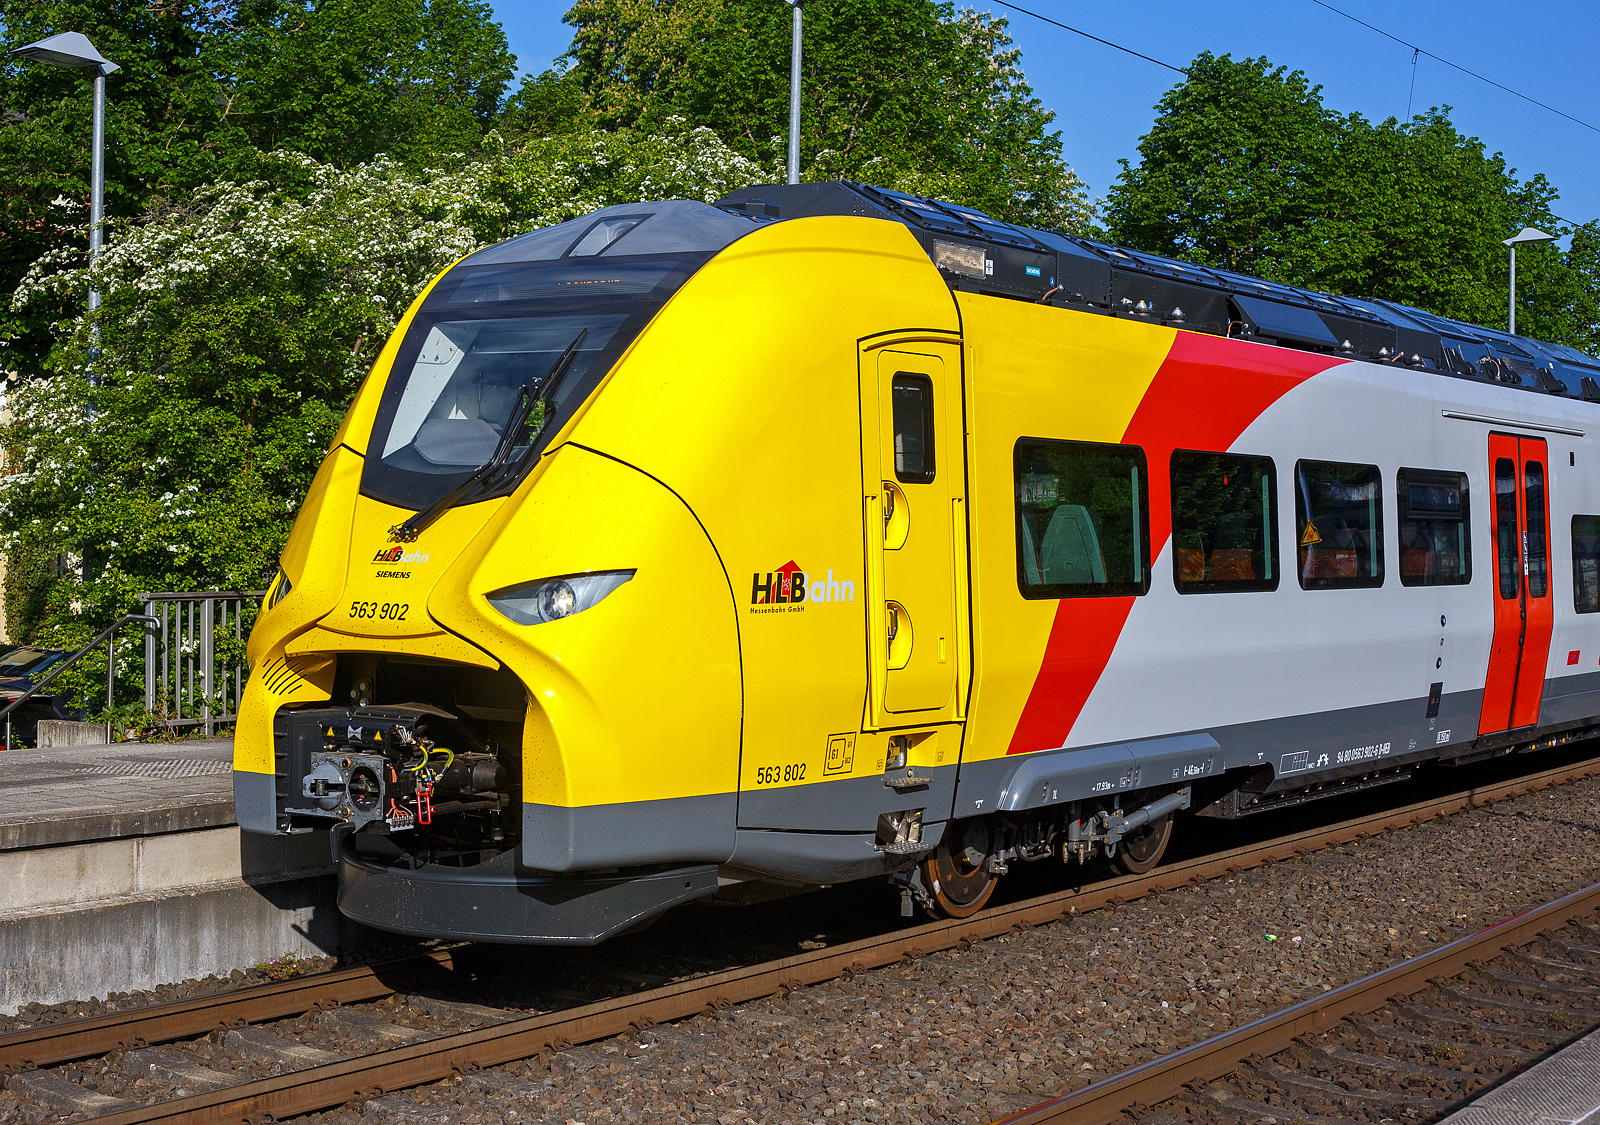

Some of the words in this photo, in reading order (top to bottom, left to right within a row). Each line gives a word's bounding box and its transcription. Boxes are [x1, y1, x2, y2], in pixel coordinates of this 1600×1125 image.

[375, 570, 411, 579] SIEMENS
[349, 601, 378, 618] 563
[379, 602, 409, 621] 902
[749, 606, 786, 614] Hessenbahn
[788, 605, 805, 613] GmbH
[757, 766, 781, 784] 563
[784, 763, 807, 781] 802
